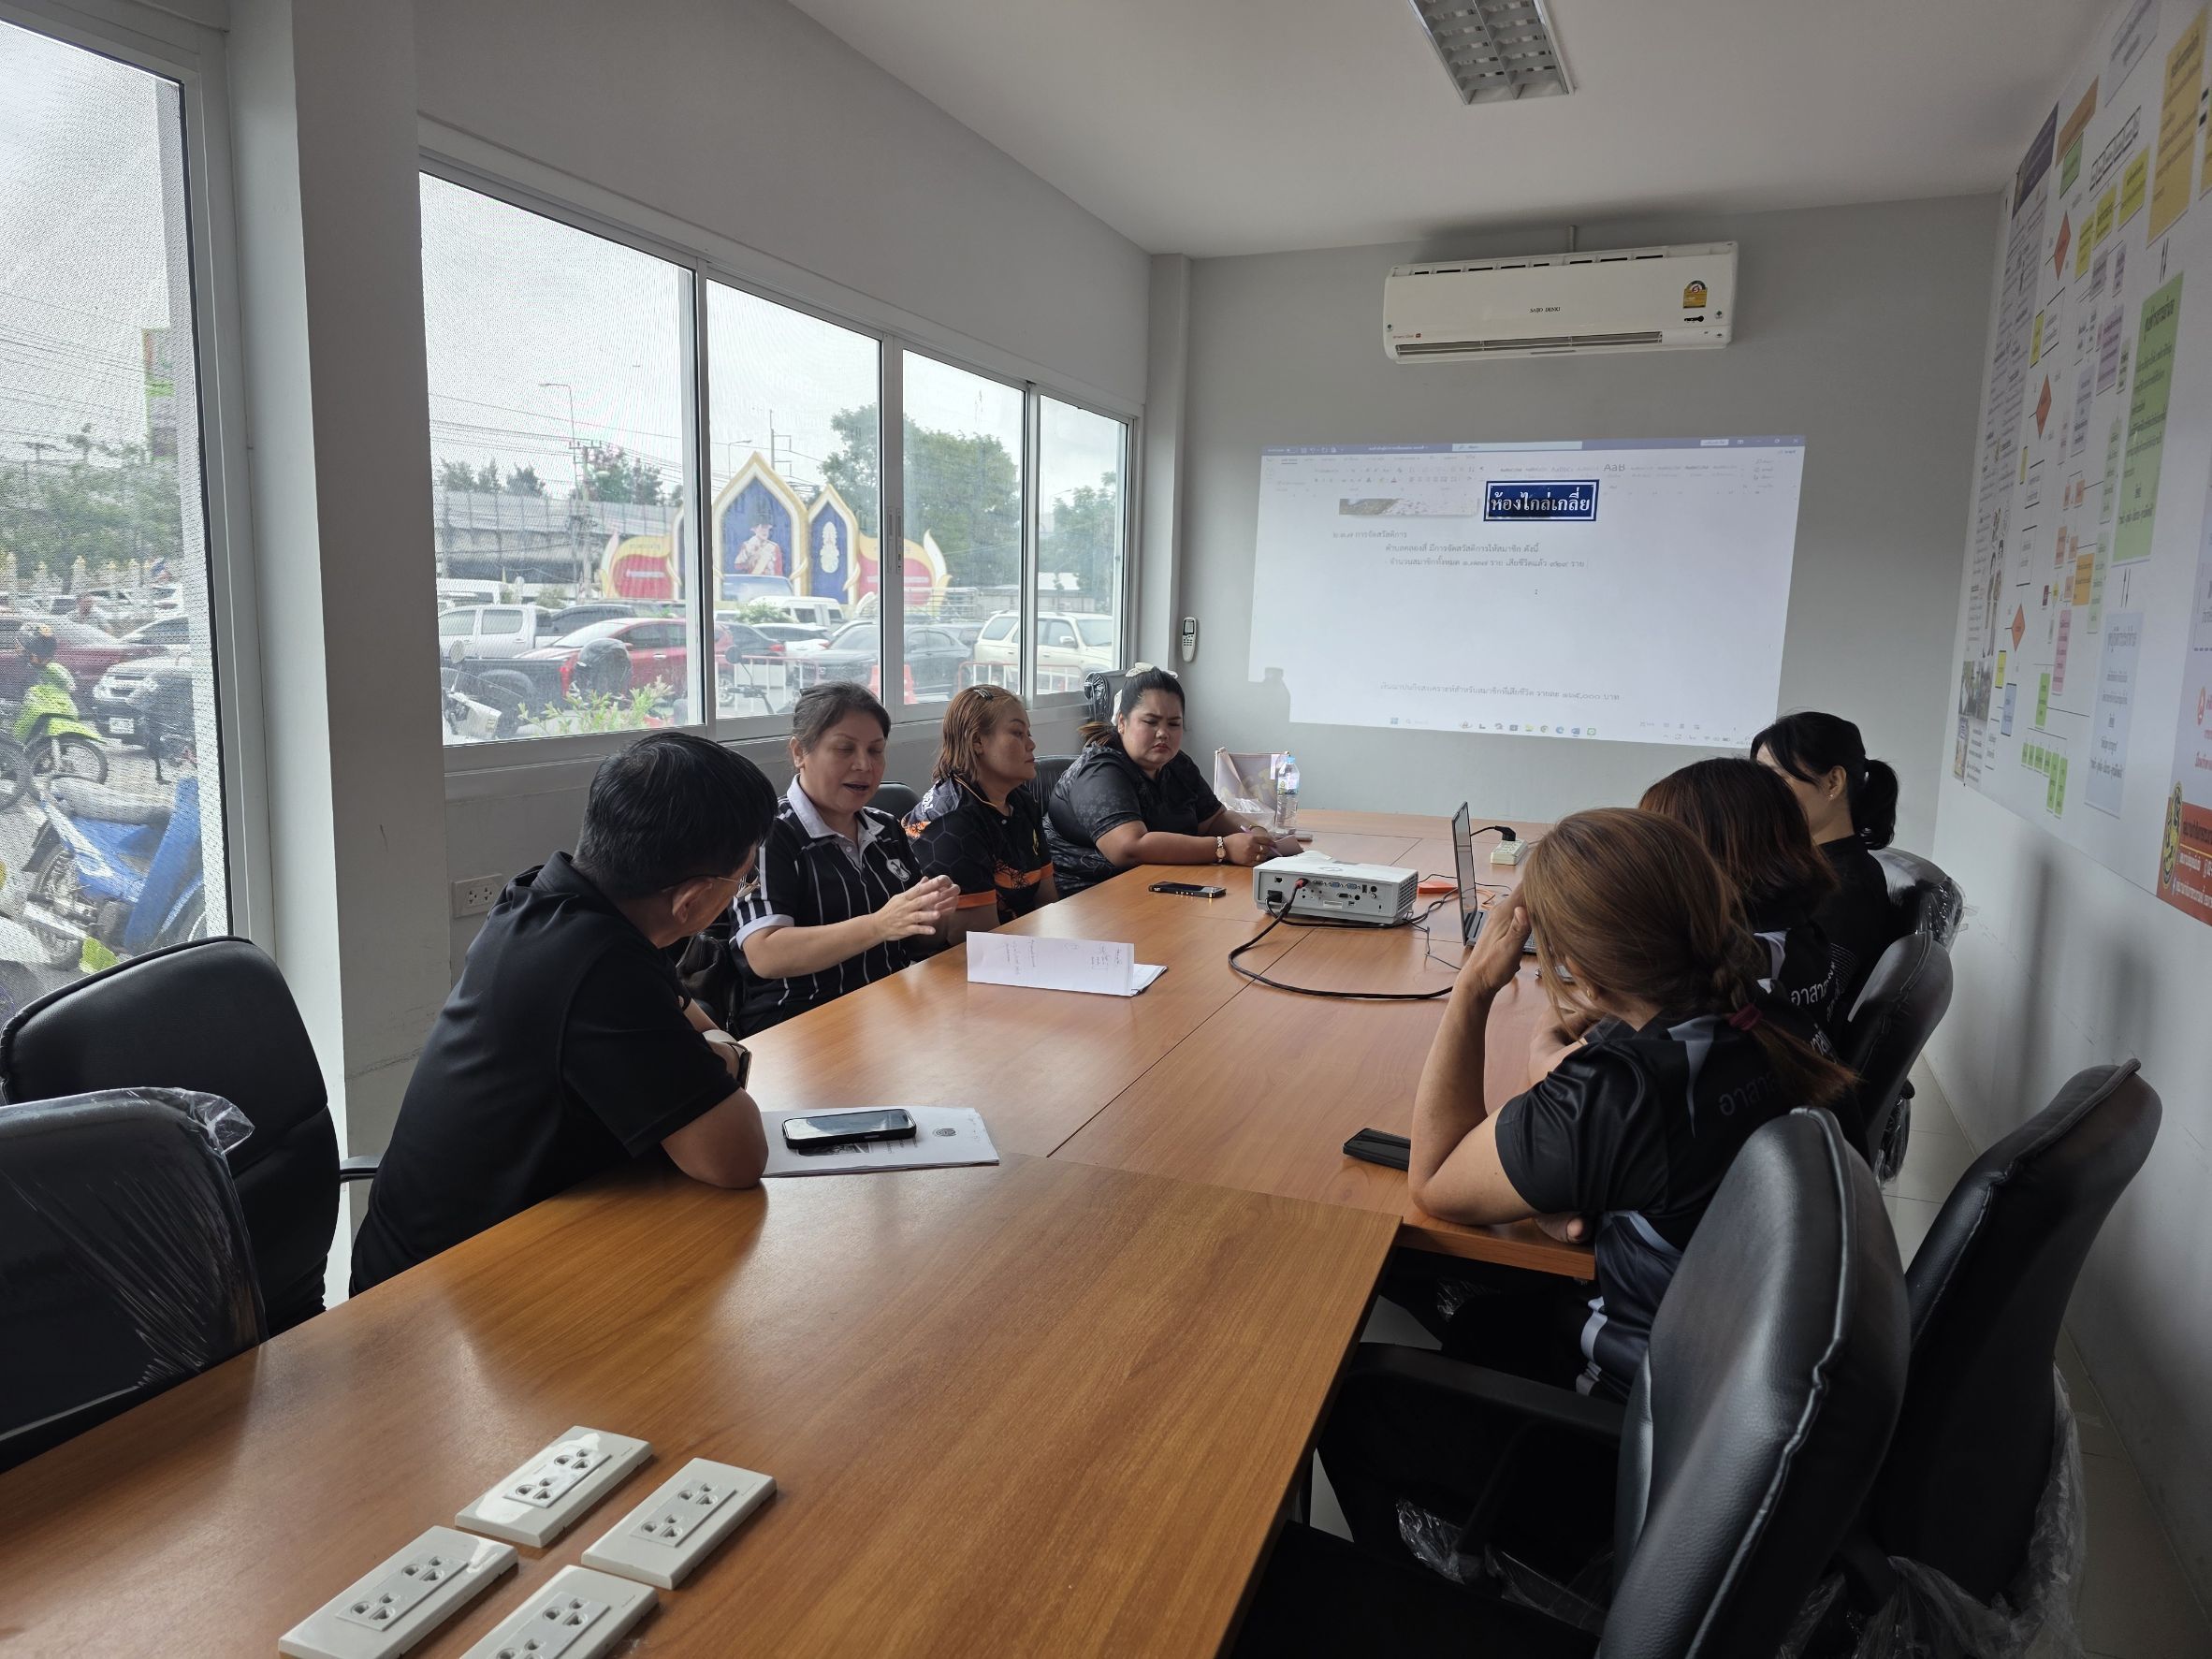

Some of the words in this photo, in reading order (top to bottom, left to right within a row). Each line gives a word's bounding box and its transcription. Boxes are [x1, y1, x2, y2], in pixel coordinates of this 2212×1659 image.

[1491, 487, 1591, 511] ห้องไกล่เกลี่ย
